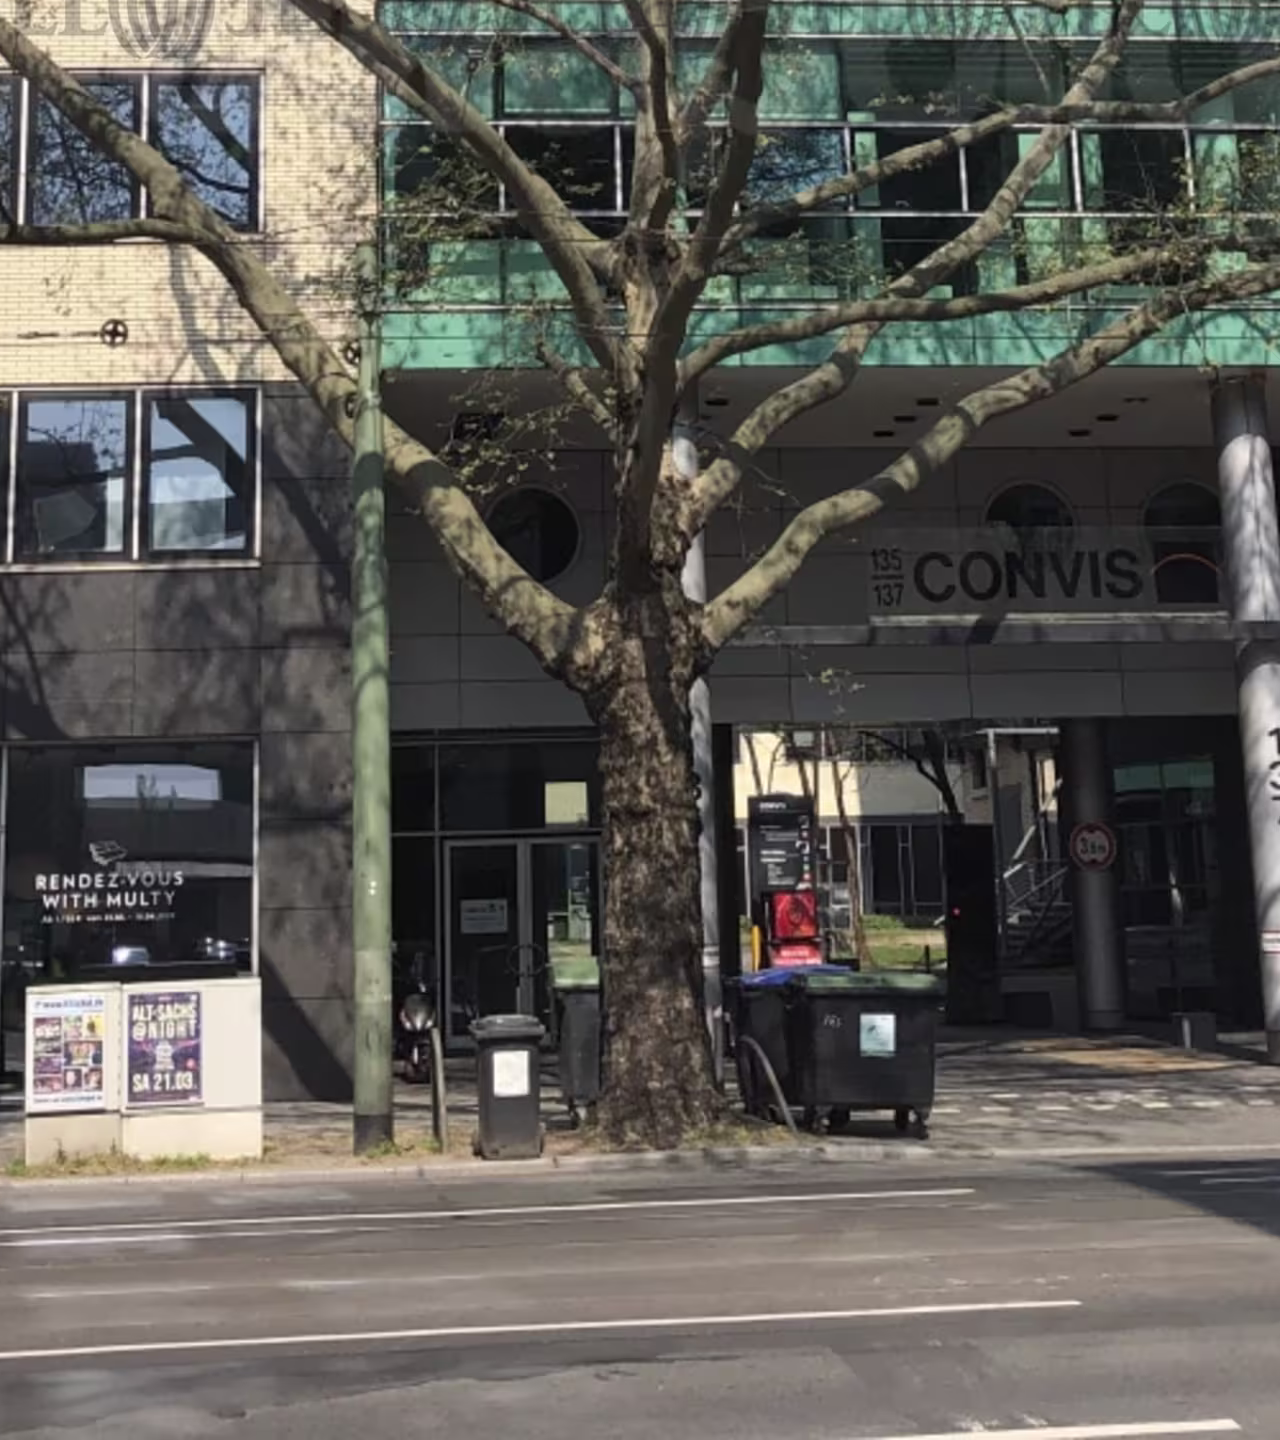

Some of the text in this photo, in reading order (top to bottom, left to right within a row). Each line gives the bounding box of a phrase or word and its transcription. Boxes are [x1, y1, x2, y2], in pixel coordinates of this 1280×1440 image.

[872, 548, 902, 571] 135
[913, 548, 1143, 603] CONVIS
[873, 583, 904, 607] 137
[35, 871, 185, 890] RENDEZ-VOUS
[42, 891, 176, 909] WITH MULTY
[132, 1020, 197, 1041] @NIGHT
[132, 1071, 198, 1093] SA 21.03.
